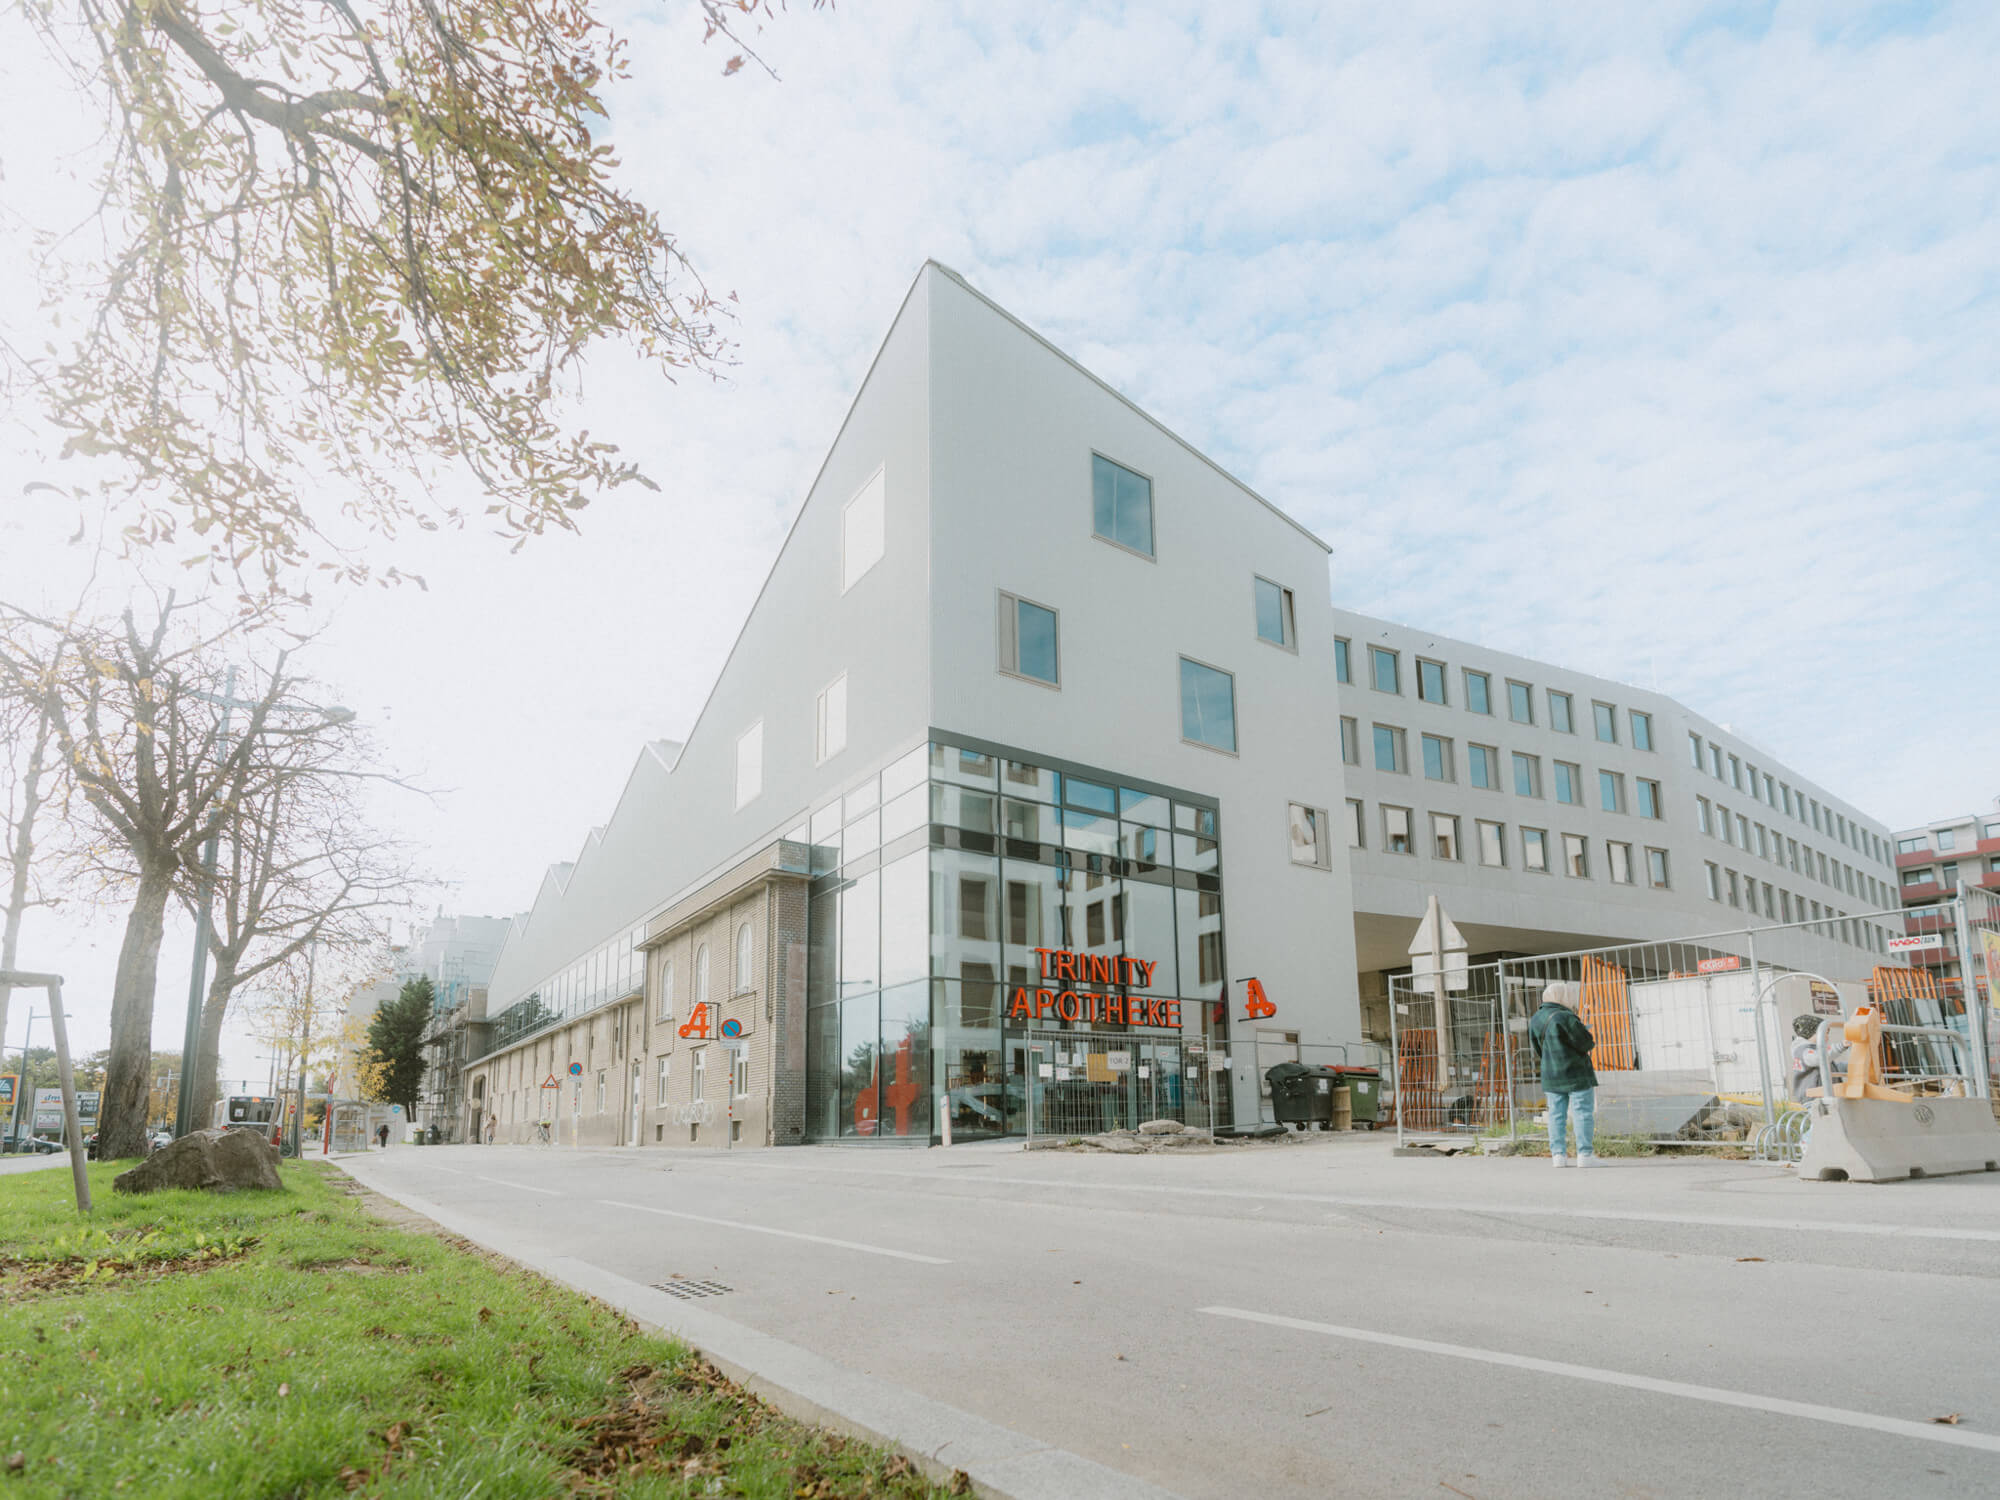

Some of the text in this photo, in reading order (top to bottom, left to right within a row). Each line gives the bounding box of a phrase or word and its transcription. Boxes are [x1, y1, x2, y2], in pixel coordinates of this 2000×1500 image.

[1034, 947, 1158, 987] TRINITY
[1010, 987, 1183, 1028] APOTHEKE
[1245, 979, 1277, 1018] A
[678, 1002, 710, 1038] A
